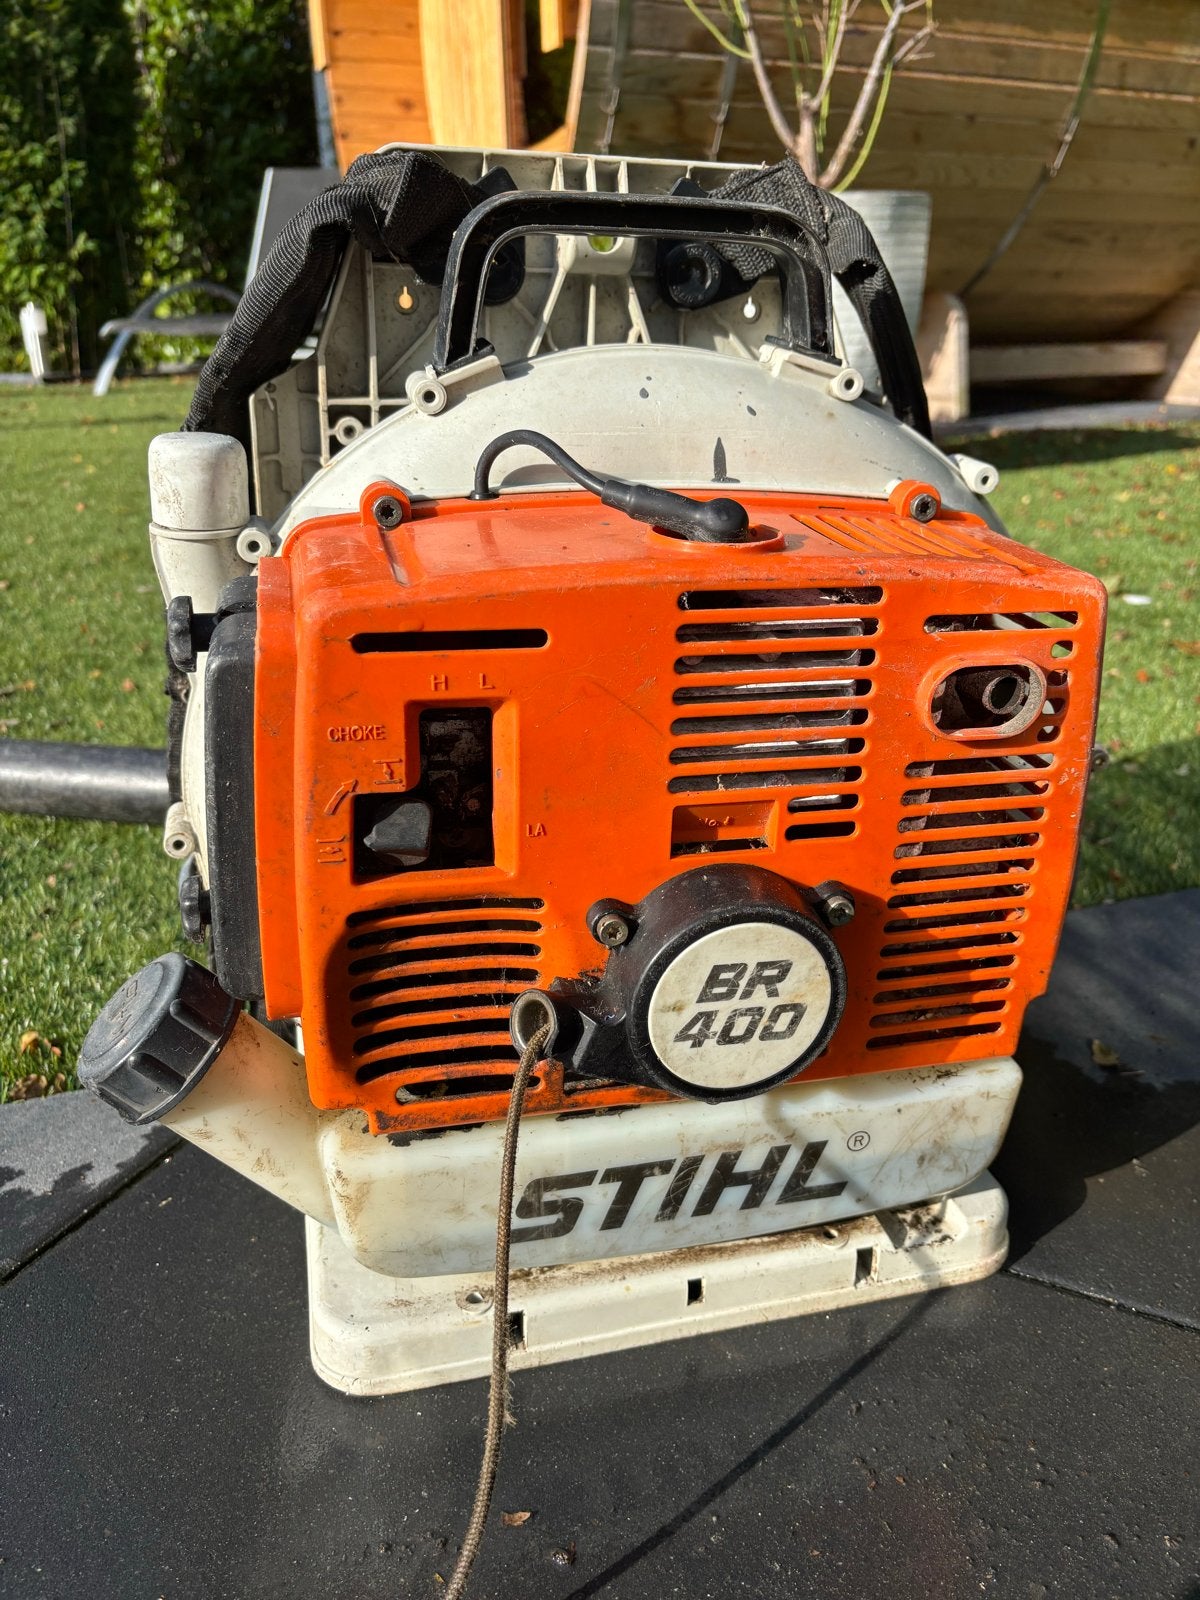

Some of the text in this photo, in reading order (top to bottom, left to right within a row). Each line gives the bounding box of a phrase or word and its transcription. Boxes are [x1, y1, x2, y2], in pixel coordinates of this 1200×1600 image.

[430, 673, 495, 691] H L
[327, 725, 386, 742] CHOKE
[525, 823, 547, 837] LA
[696, 959, 793, 1004] BR
[673, 1002, 808, 1048] 400
[510, 1140, 848, 1244] STIHL
